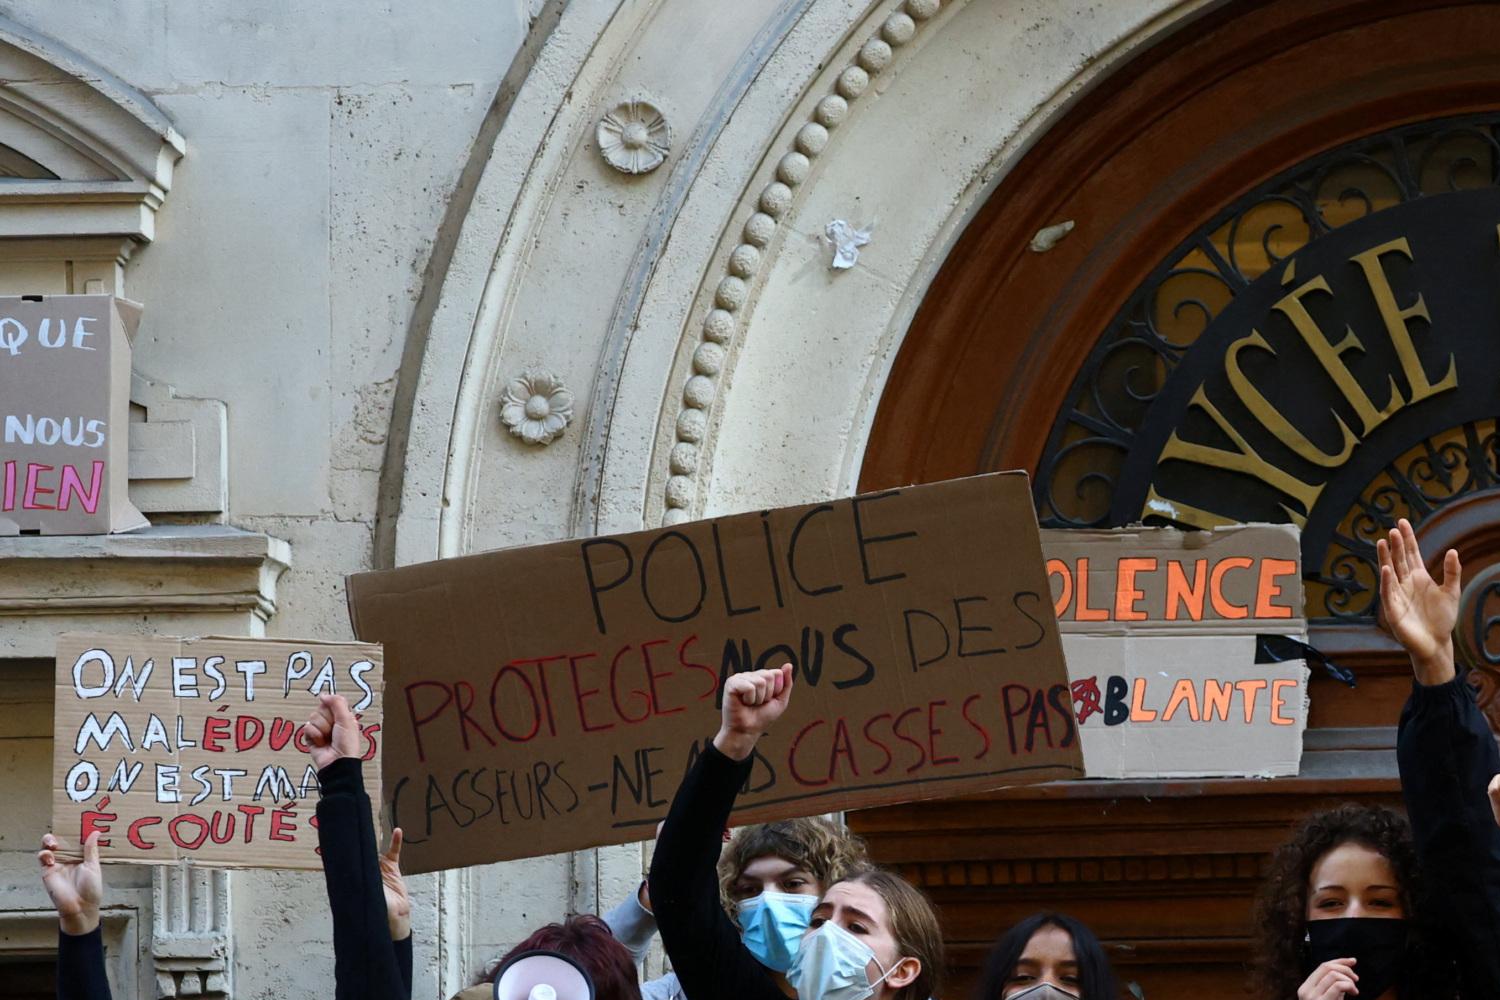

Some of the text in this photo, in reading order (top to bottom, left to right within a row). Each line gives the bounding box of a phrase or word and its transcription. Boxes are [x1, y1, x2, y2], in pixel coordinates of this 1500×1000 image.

[5, 414, 106, 447] NOUS
[3, 461, 104, 513] IEN
[1046, 557, 1297, 622] OLENCE
[71, 648, 375, 712] ON EST PAS
[403, 634, 720, 763] PROTEGES
[904, 591, 1046, 674] DES
[788, 694, 992, 787] CASSES
[1001, 684, 1074, 755] PAS
[65, 759, 324, 807] ON EST MA
[80, 797, 322, 856] ÉCOUTÉ
